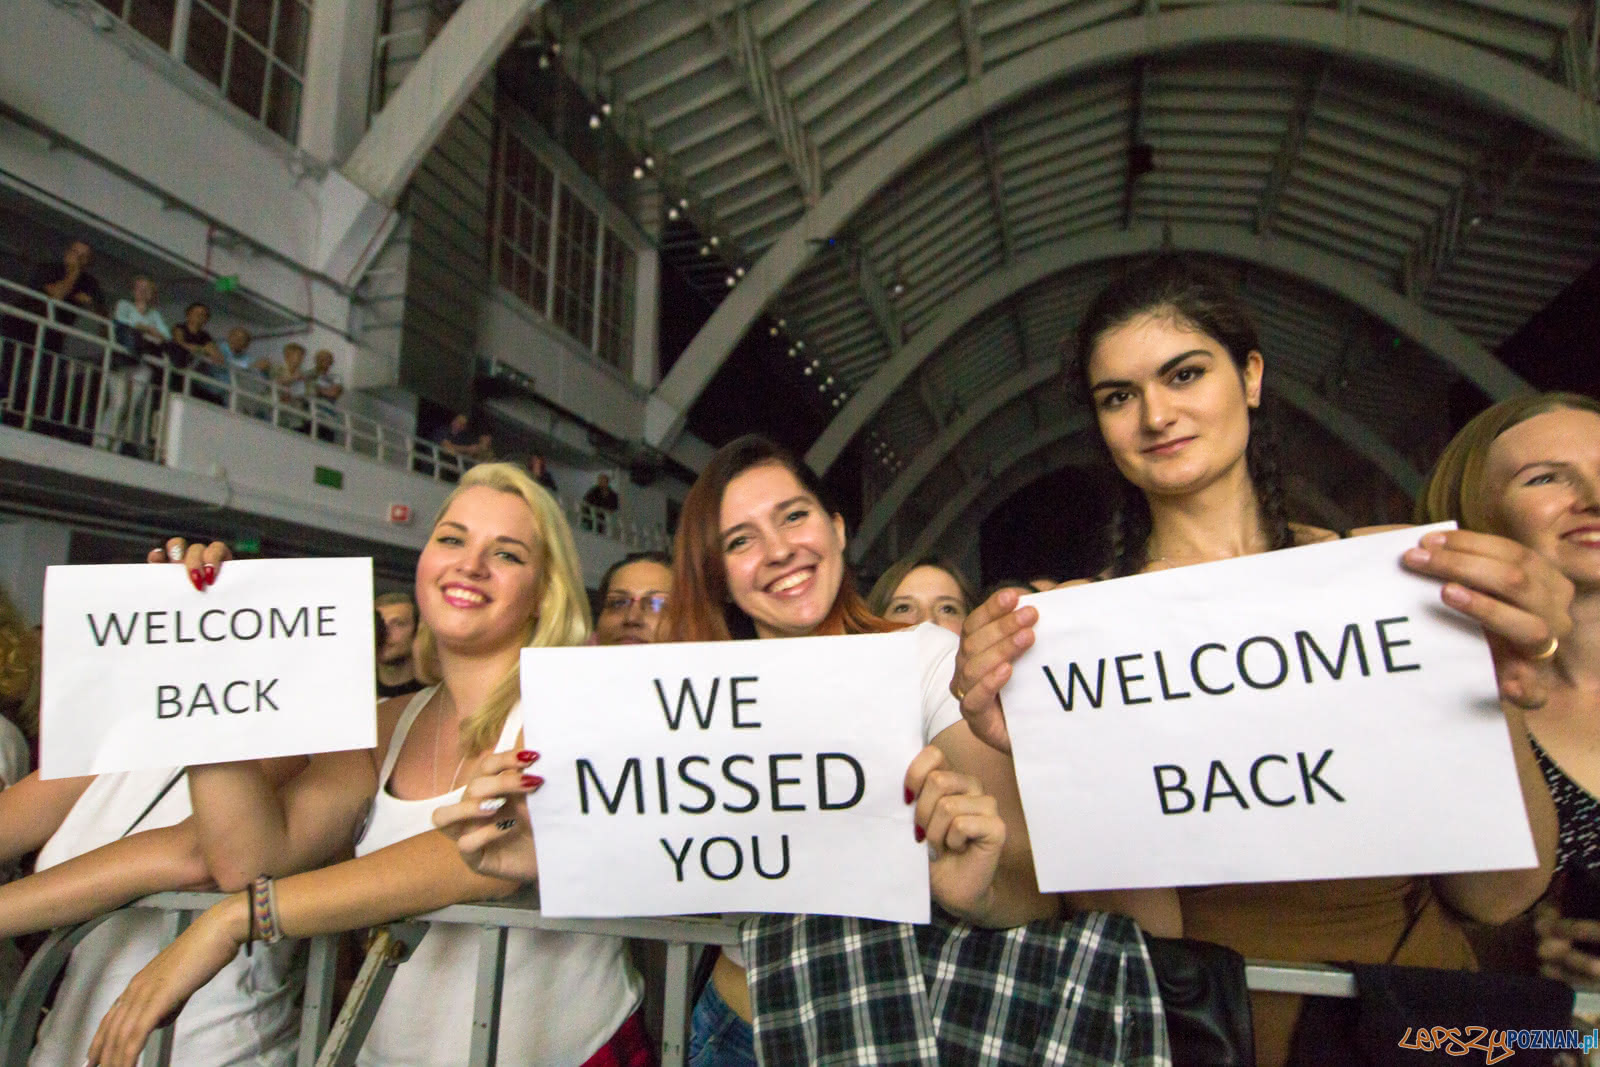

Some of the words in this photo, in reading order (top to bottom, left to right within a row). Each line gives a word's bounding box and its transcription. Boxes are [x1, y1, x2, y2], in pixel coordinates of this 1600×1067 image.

[87, 606, 336, 647] WELCOME
[1042, 616, 1421, 712] WELCOME
[157, 678, 279, 719] BACK
[654, 676, 761, 731] WE
[575, 752, 866, 815] MISSED
[1153, 749, 1346, 815] BACK
[660, 834, 790, 882] YOU
